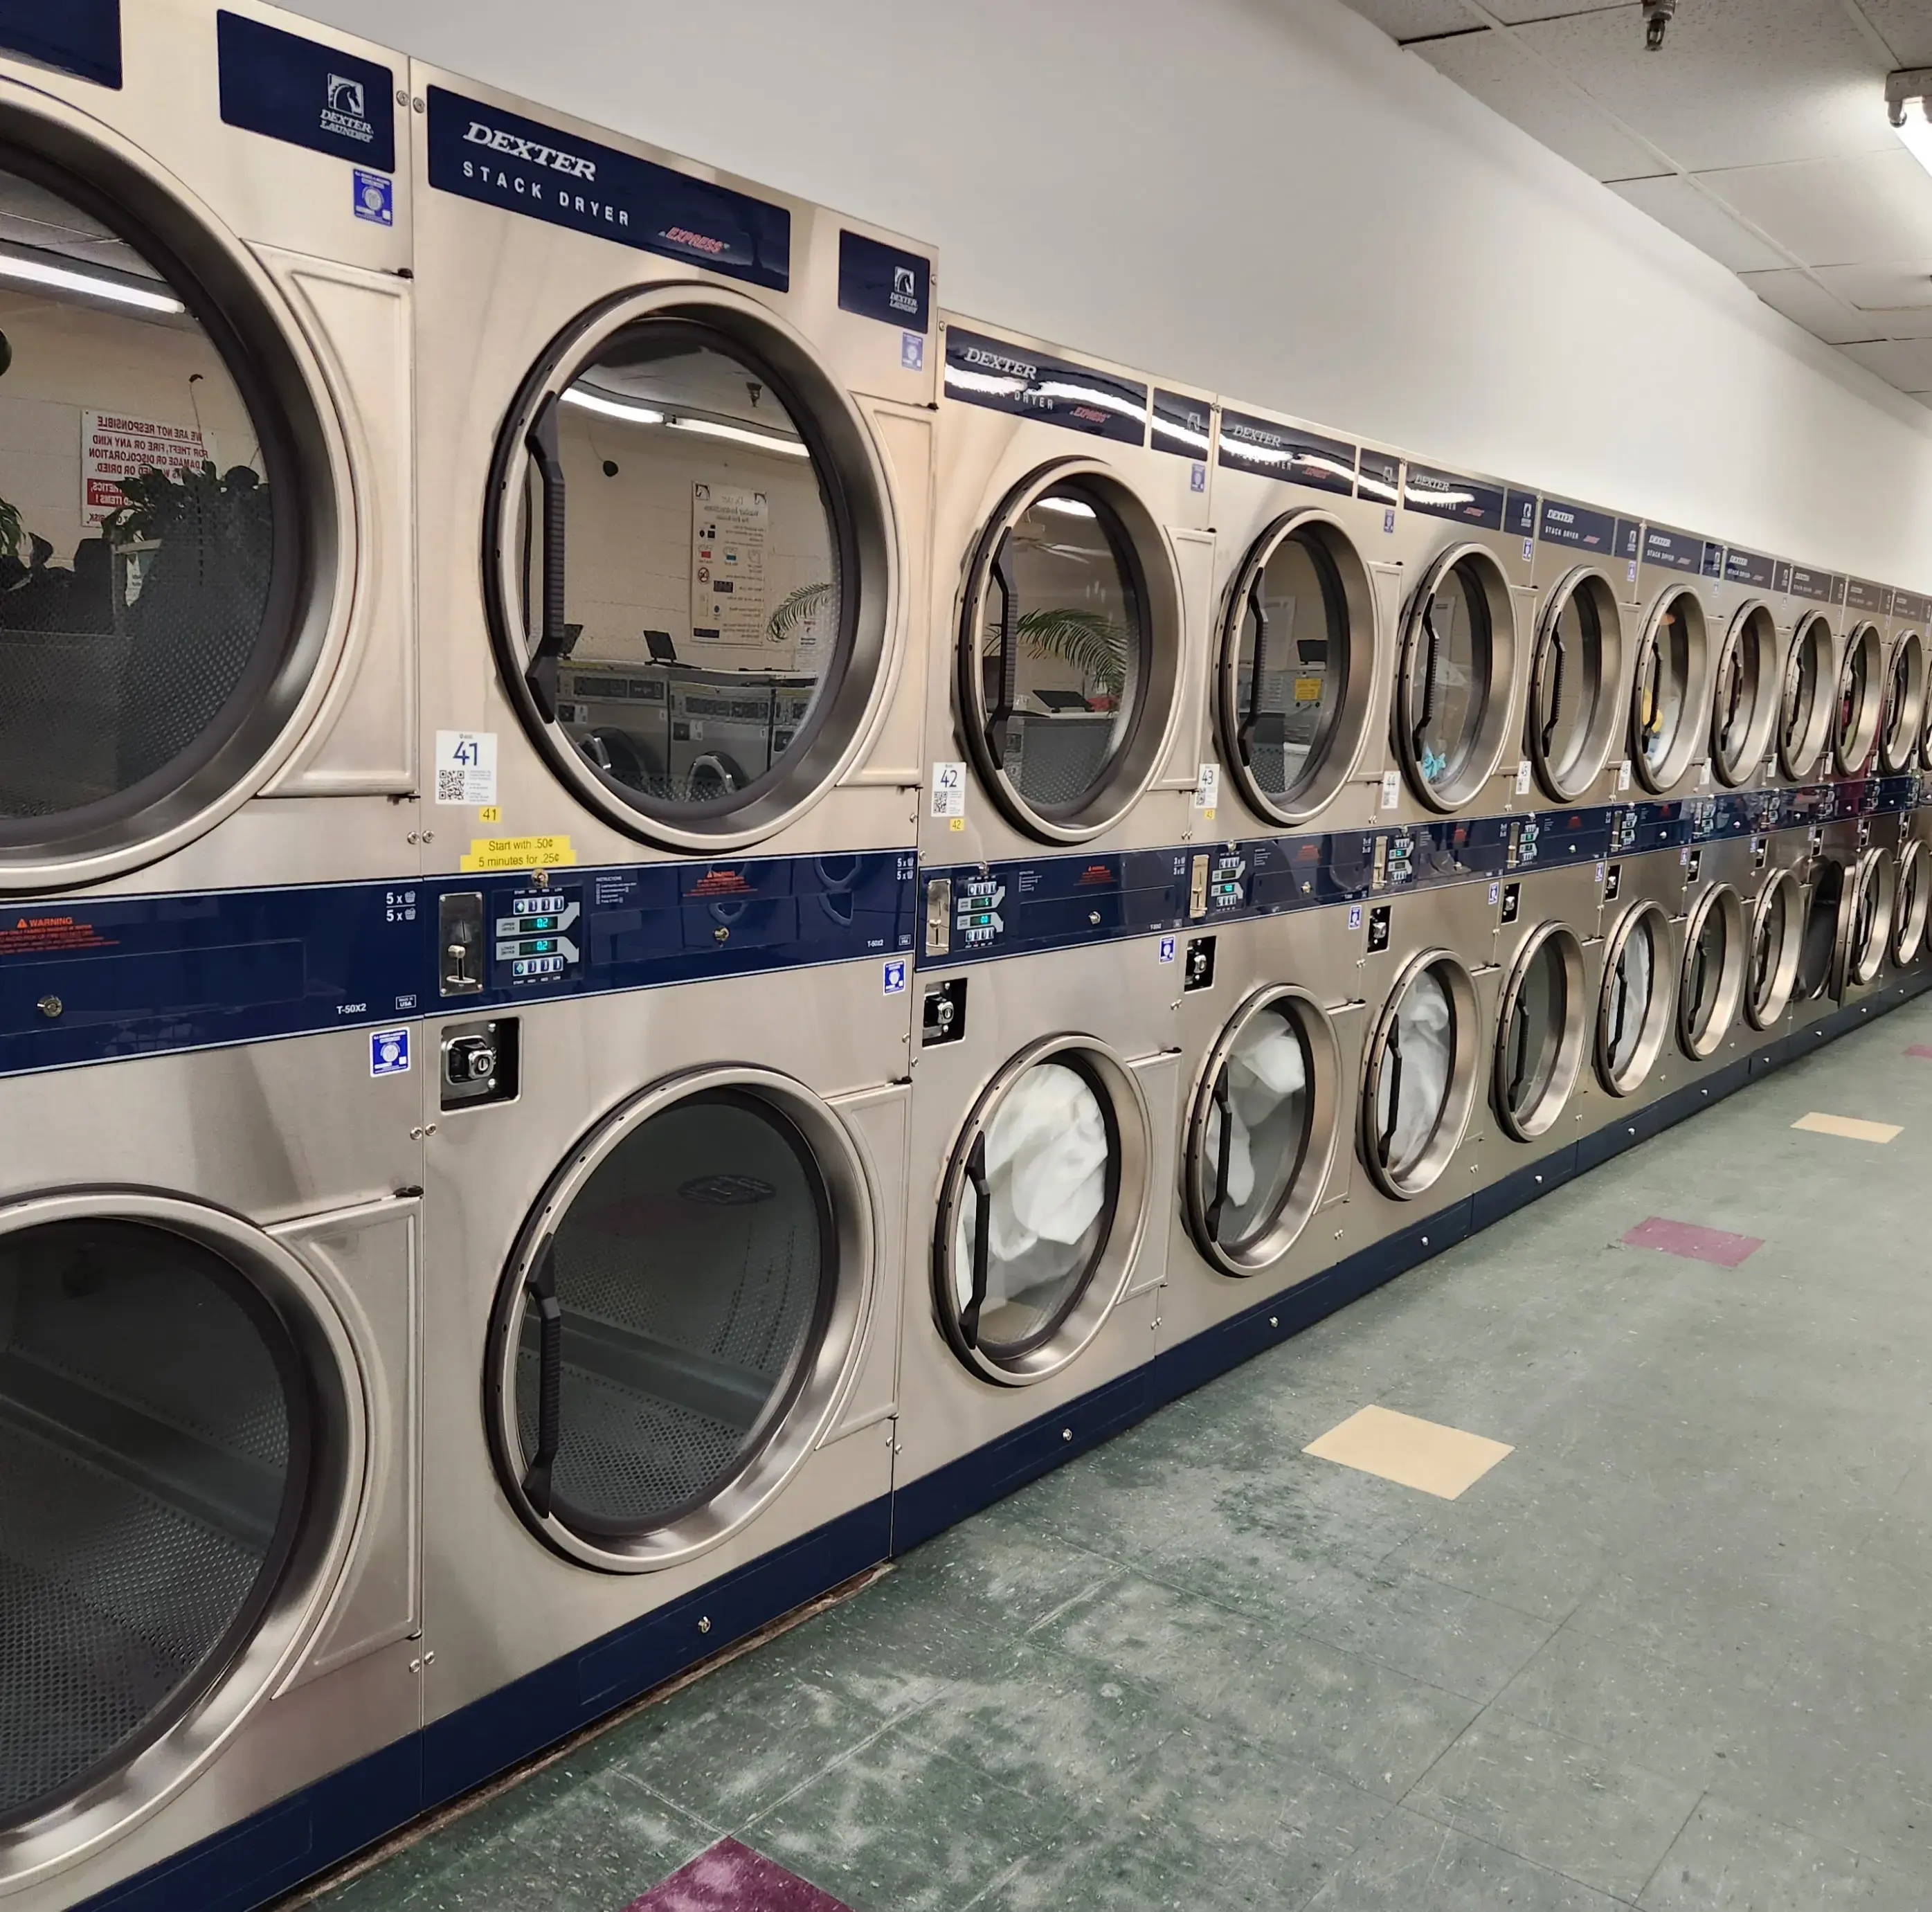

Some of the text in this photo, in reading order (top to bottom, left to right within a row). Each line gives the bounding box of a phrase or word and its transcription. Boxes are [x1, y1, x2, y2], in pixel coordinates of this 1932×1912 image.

[320, 109, 373, 134] DEXTER
[319, 120, 374, 143] LAUNDRY
[462, 121, 596, 181] DEXTER
[462, 161, 629, 227] STACK DRYER
[665, 226, 725, 254] EXPRESS
[890, 292, 917, 307] DEXTER
[964, 347, 1037, 380] DEXTER
[1014, 390, 1054, 410] DRYER
[1233, 424, 1281, 447] DEXTER
[1415, 474, 1450, 491] DEXTER
[1546, 509, 1574, 523] DEXTER
[453, 741, 478, 766] 41
[940, 770, 958, 788] 42
[1202, 770, 1213, 785] 43
[482, 808, 497, 821] 41
[952, 819, 962, 830] 42
[489, 838, 553, 851] Start with .50¢
[478, 853, 559, 867] 5 minutes for .25¢
[897, 858, 902, 867] 5
[896, 870, 902, 881] 5
[386, 892, 394, 904] 5
[29, 917, 73, 928] WARNING
[386, 910, 394, 922] 5
[336, 1003, 367, 1015] T-50X2
